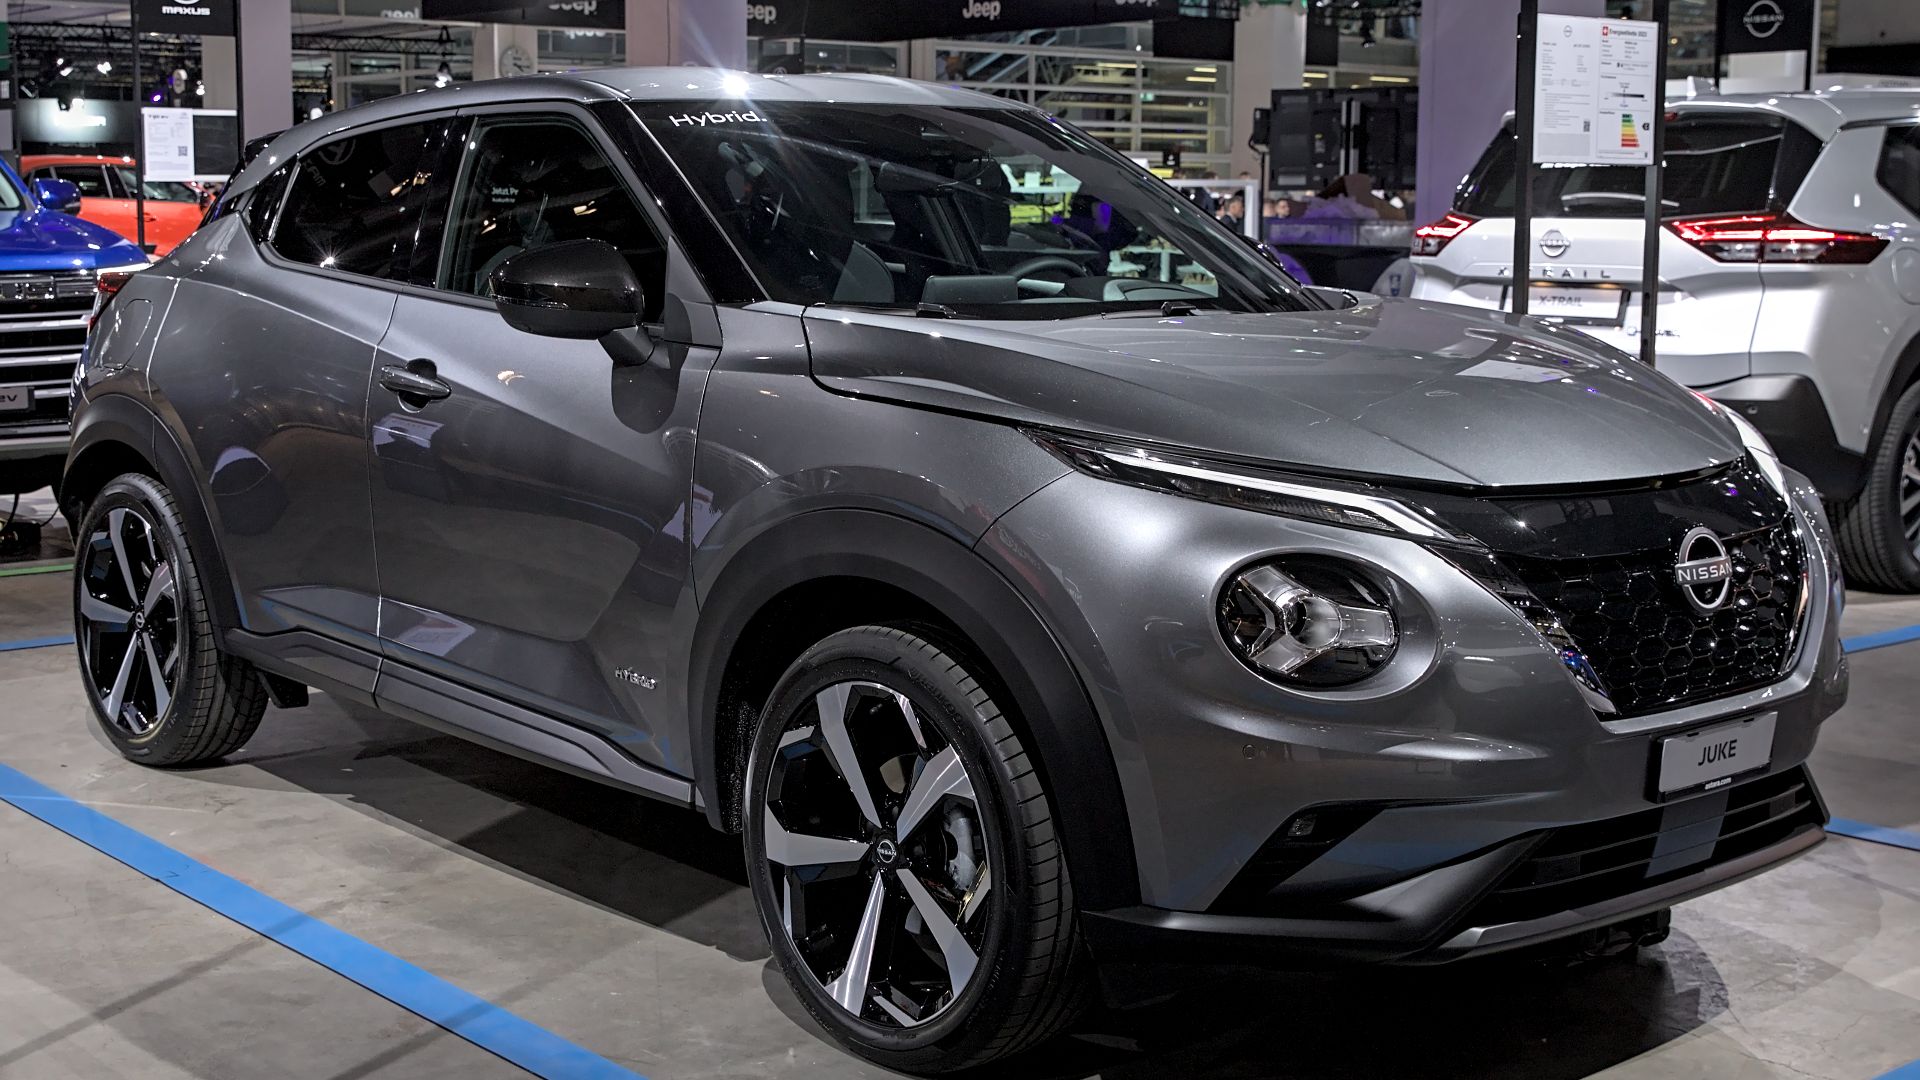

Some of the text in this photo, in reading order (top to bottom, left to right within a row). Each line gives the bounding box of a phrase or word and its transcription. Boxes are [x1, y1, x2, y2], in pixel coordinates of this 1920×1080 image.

[162, 5, 211, 16] MAXUS
[747, 4, 777, 25] eep
[962, 0, 1001, 21] Jeep
[669, 110, 767, 127] Hybrid.
[1677, 561, 1733, 582] NISSAN
[1698, 739, 1738, 767] JUKE
